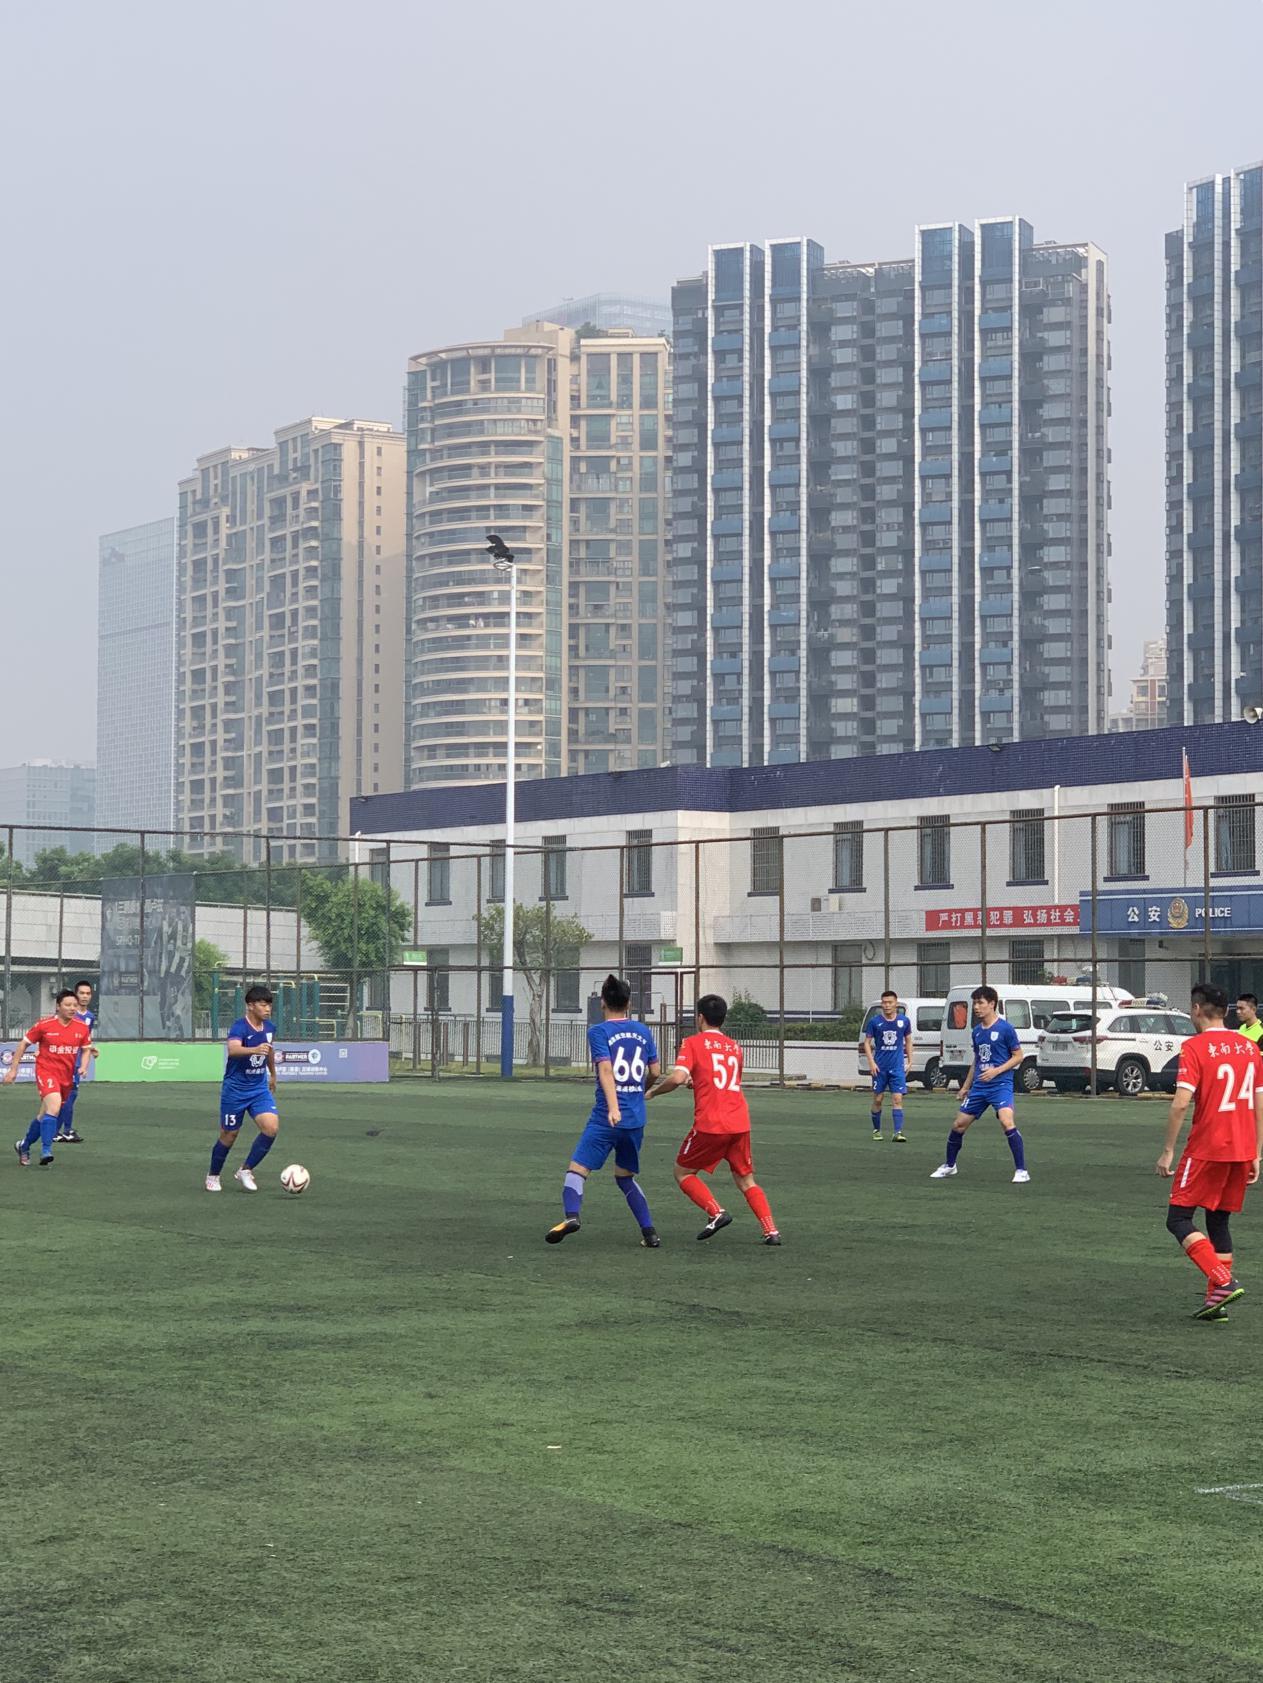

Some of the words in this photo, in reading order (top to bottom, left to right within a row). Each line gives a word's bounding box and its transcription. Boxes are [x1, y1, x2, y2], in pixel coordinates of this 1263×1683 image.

[1023, 907, 1080, 924] 弘扬社会
[1127, 906, 1160, 922] 公安
[1153, 1039, 1174, 1052] 公安
[613, 1046, 645, 1082] 66
[711, 1053, 740, 1092] 52
[47, 1078, 54, 1088] 2
[1217, 1062, 1255, 1112] 24
[224, 1114, 237, 1126] 13
